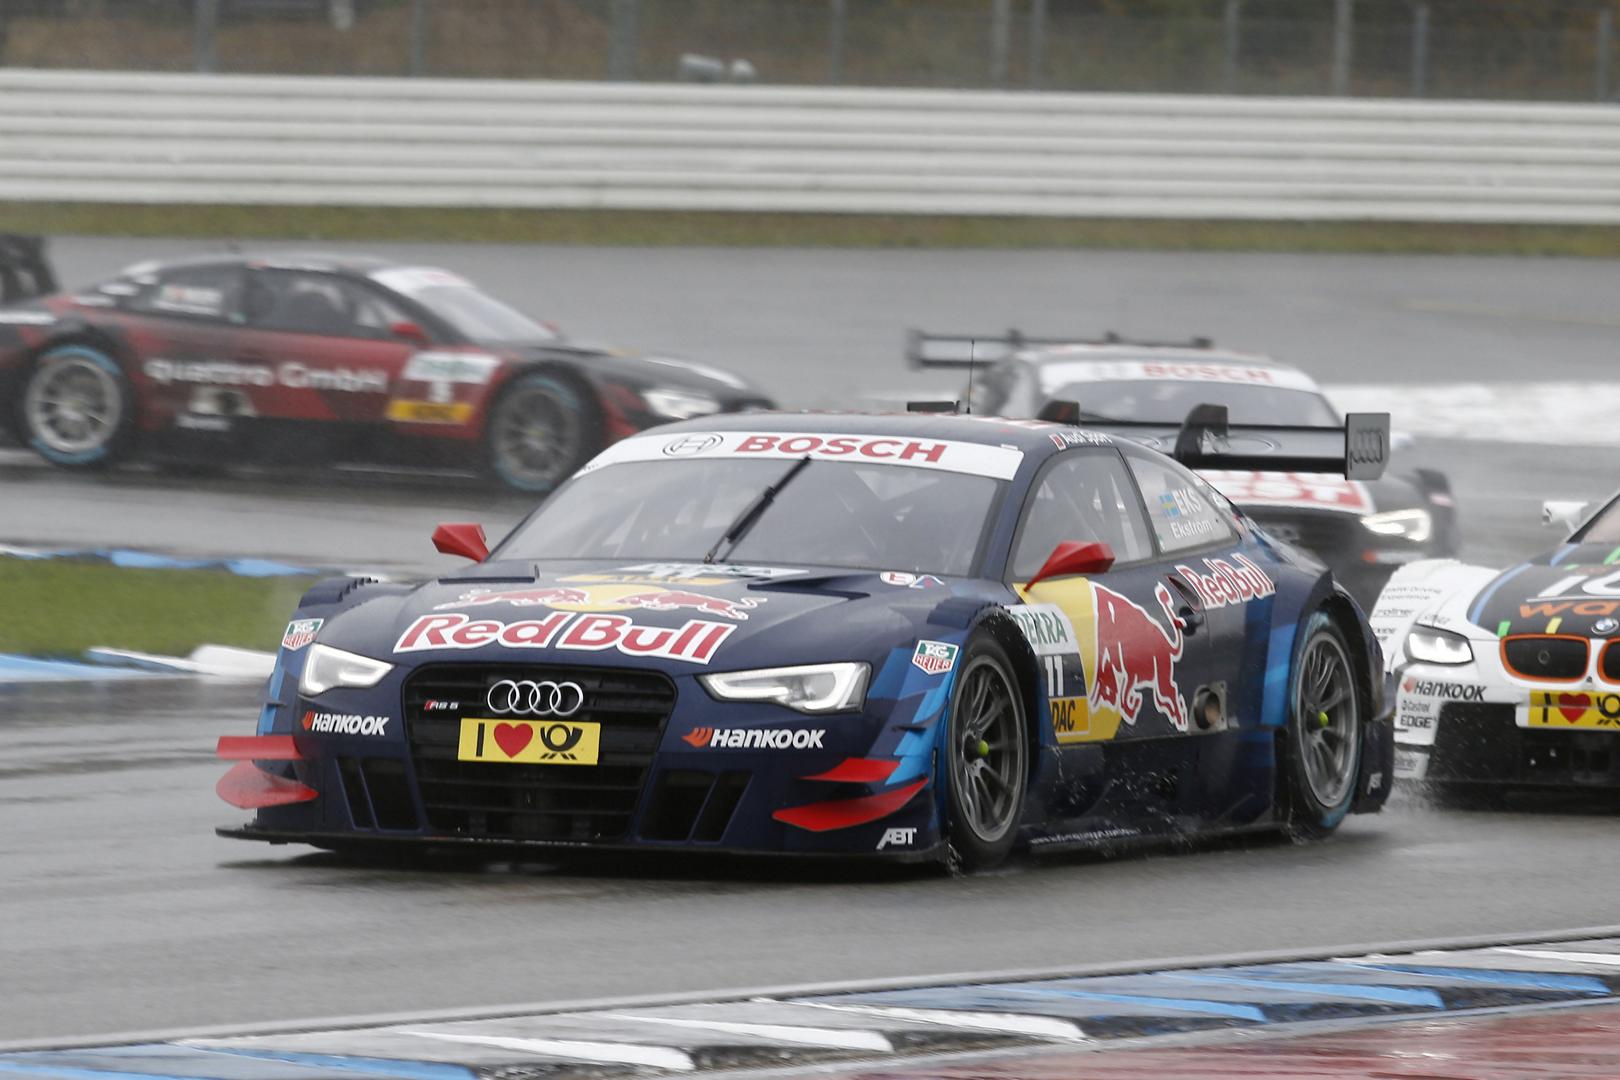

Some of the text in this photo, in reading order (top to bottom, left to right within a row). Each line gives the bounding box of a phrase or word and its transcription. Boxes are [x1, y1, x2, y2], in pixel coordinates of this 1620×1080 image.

[1142, 363, 1274, 384] BOSCH
[735, 435, 948, 463] BOSCH
[1171, 487, 1202, 516] EKS
[1174, 552, 1276, 610] Red Bull
[393, 611, 737, 665] Red Bull
[1012, 610, 1069, 644] DEKRA
[915, 654, 952, 672] HEUER
[1044, 655, 1064, 697] 11
[1399, 714, 1433, 729] EDGE
[1542, 692, 1552, 723] I
[475, 722, 486, 758] I
[876, 827, 918, 851] ABT
